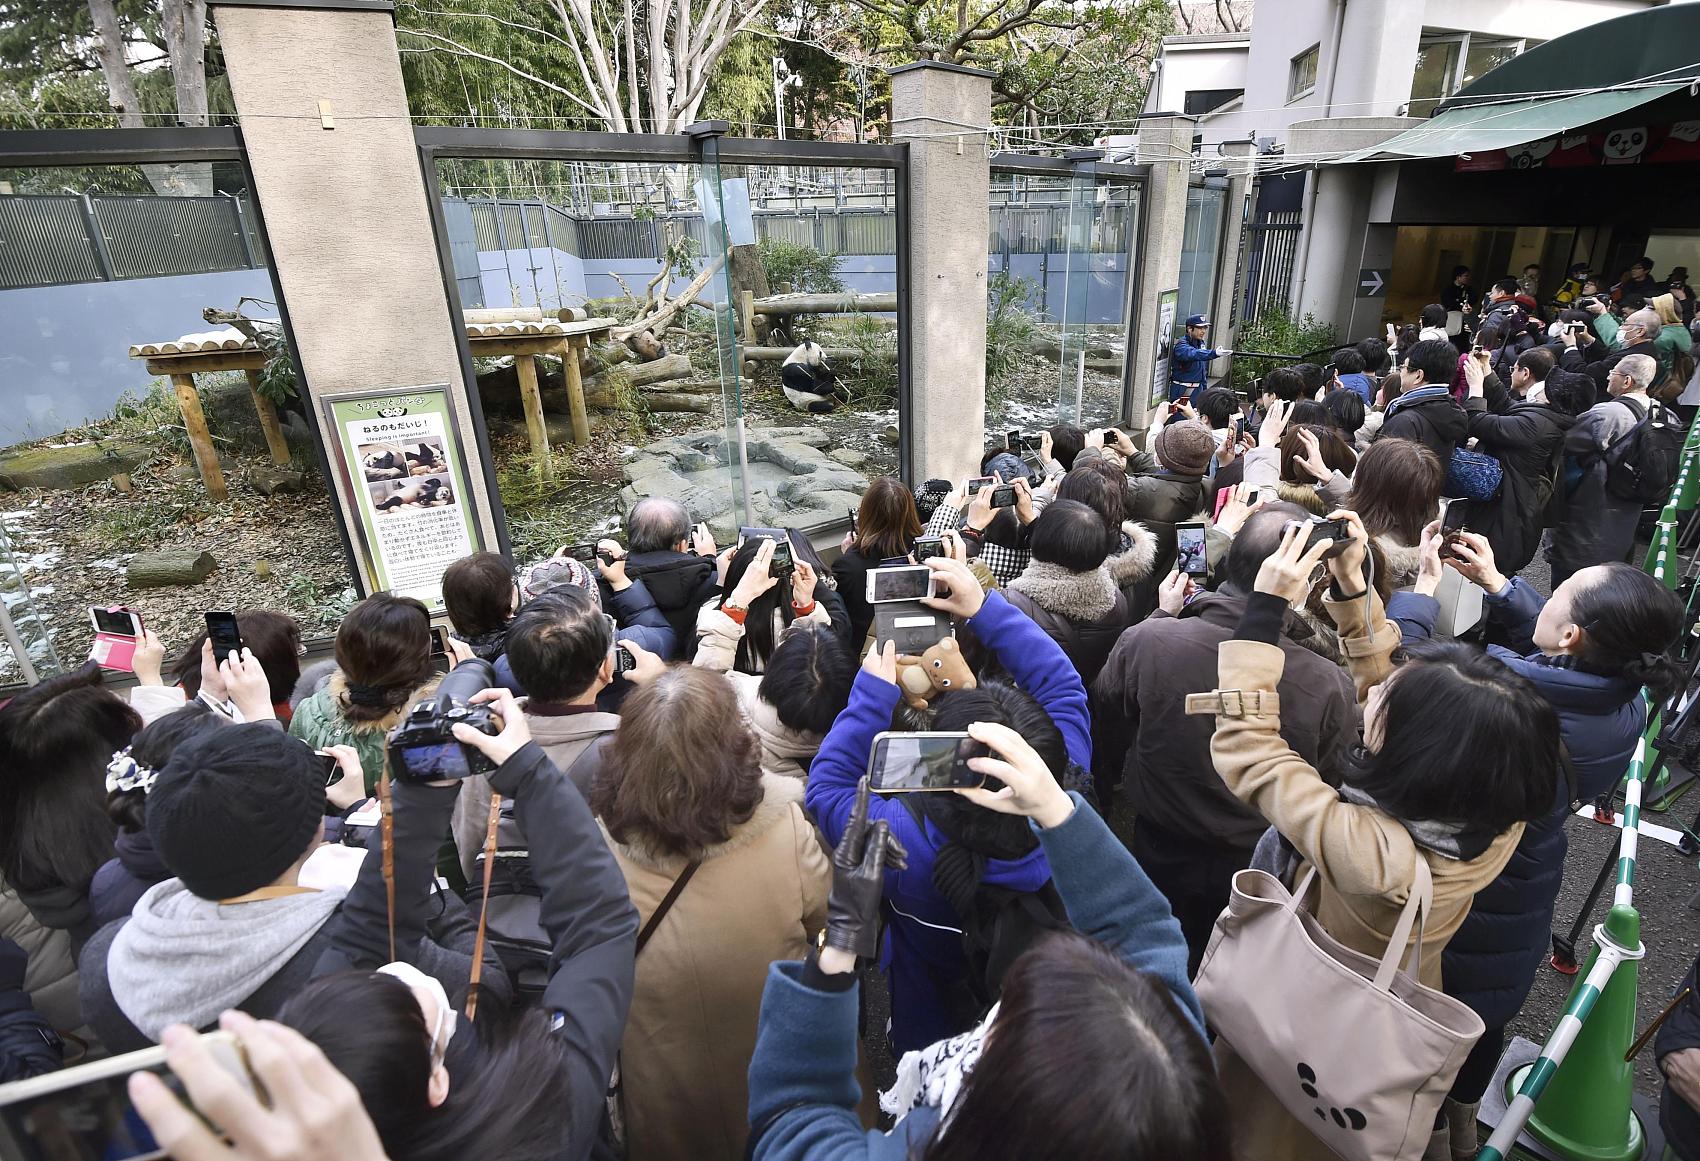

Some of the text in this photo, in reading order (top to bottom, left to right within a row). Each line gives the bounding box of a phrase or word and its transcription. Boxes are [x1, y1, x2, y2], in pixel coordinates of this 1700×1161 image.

[363, 419, 428, 433] ねるのもだいじ！
